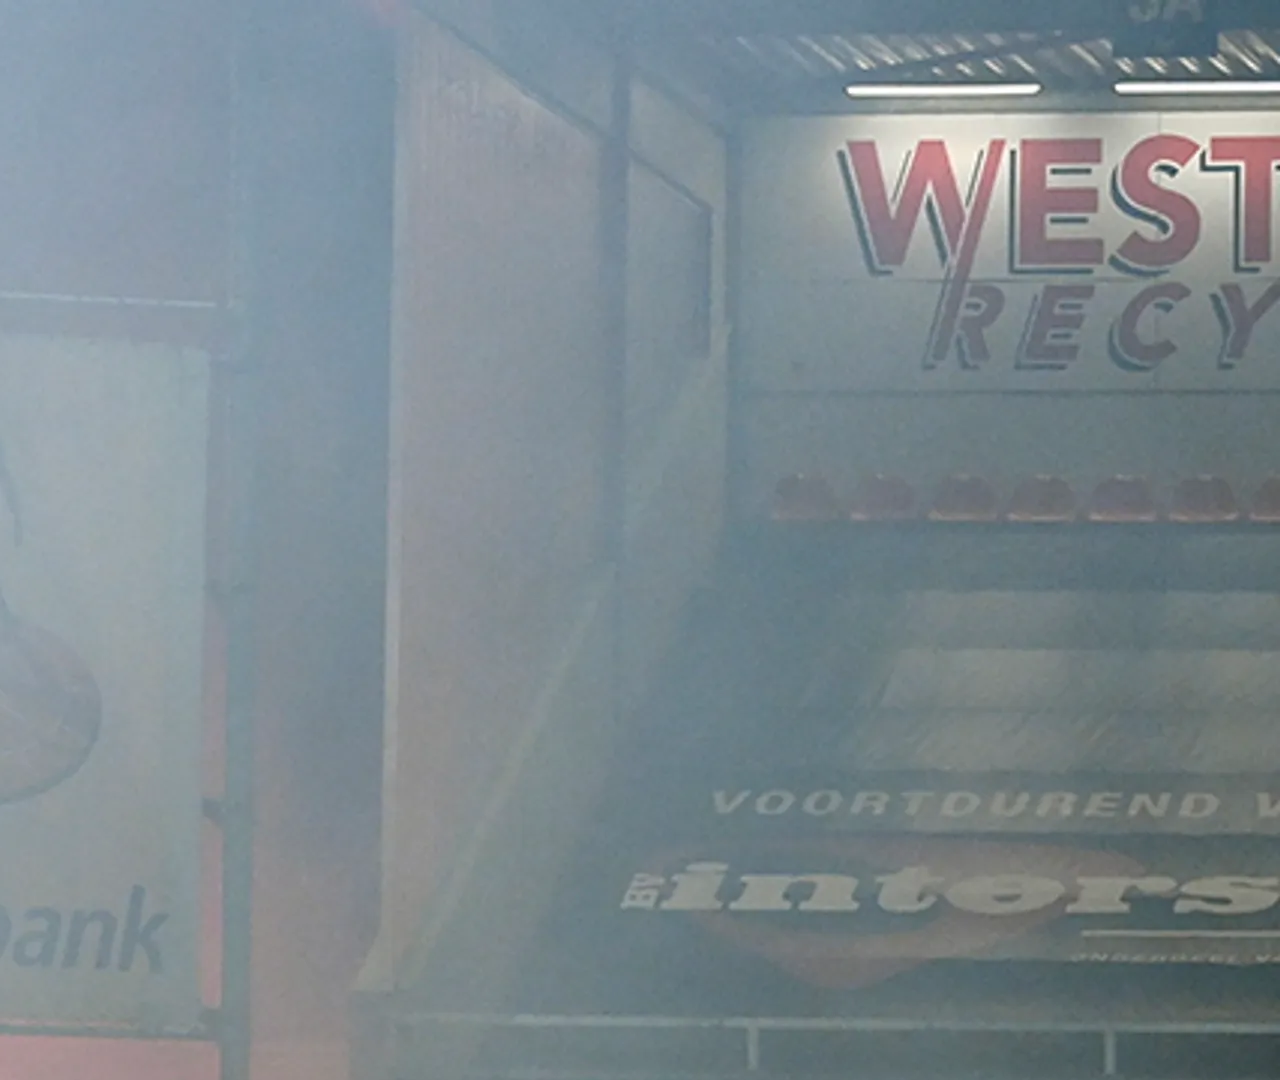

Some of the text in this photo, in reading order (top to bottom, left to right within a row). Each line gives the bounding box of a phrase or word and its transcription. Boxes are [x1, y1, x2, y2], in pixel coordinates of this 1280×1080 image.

[837, 134, 1280, 275] WEST
[922, 283, 1280, 372] RECY
[712, 787, 1222, 820] VOORTDUREND
